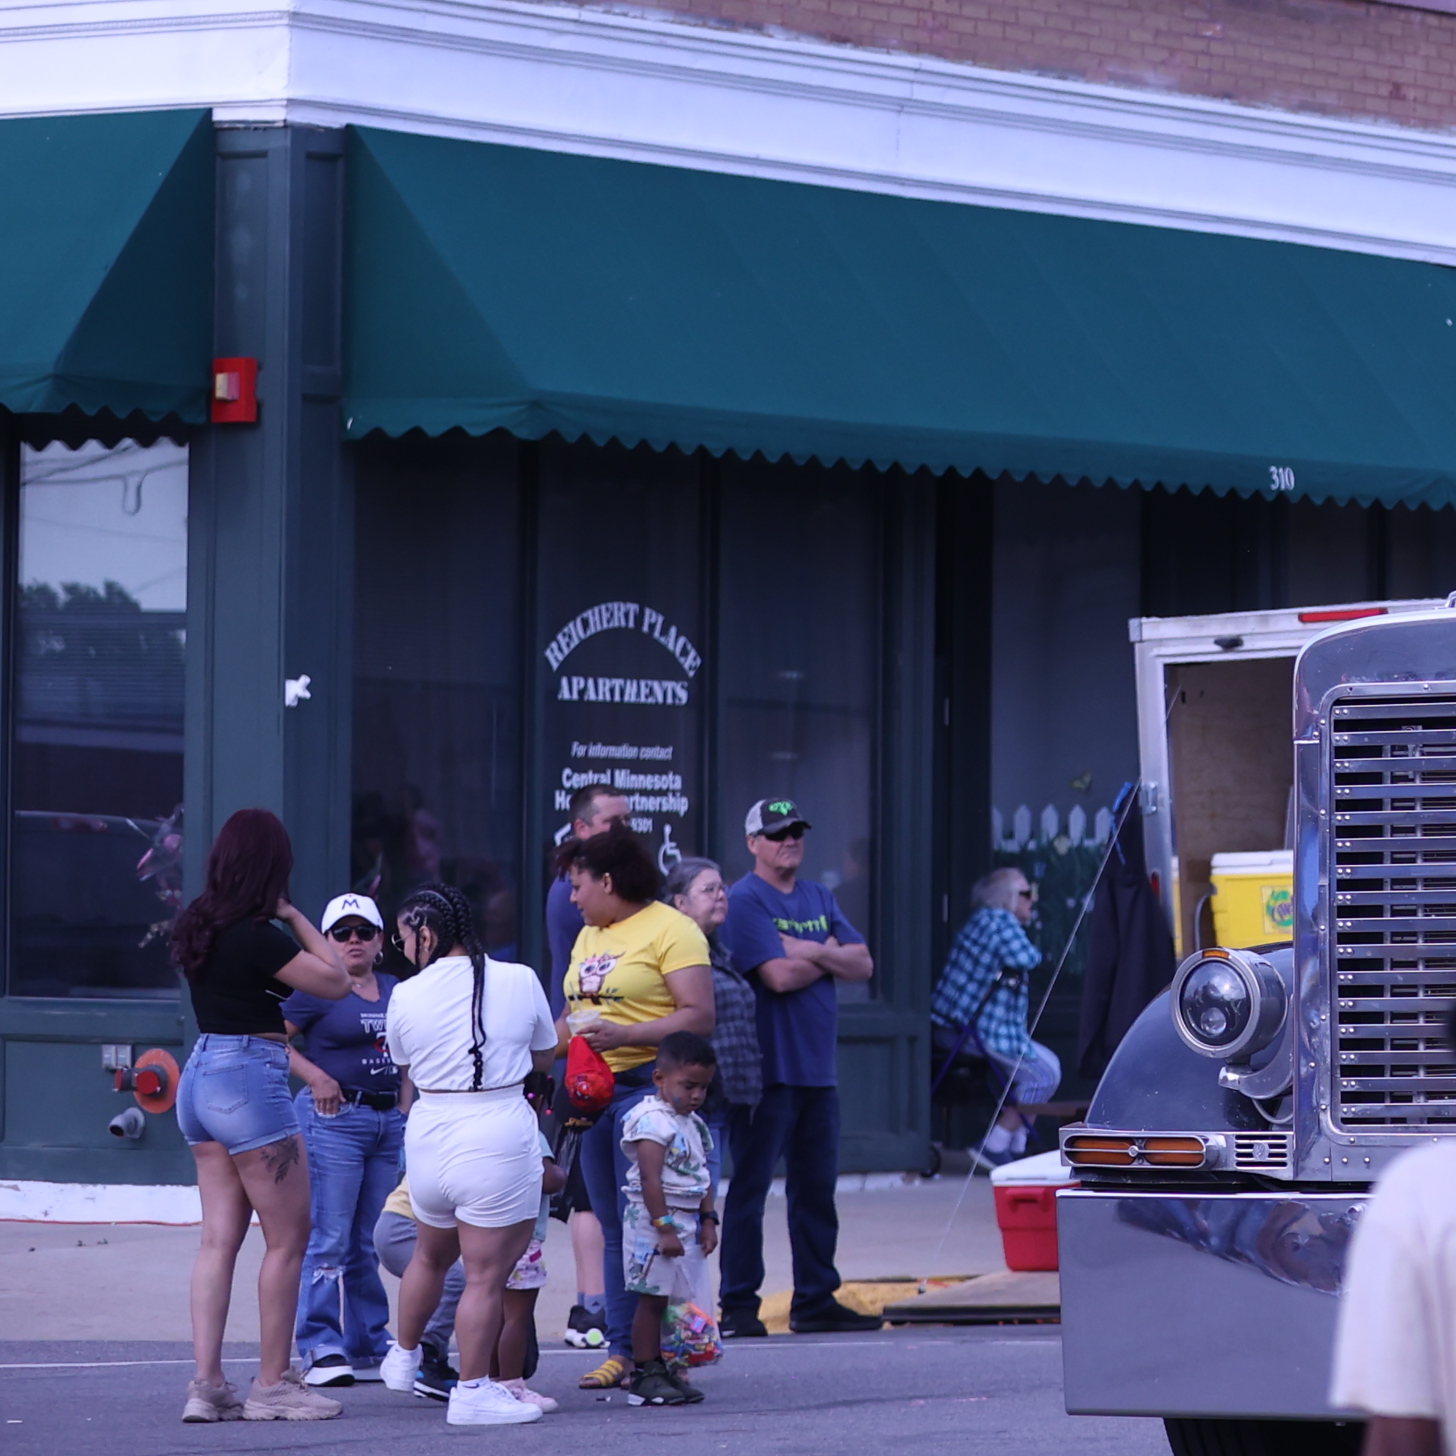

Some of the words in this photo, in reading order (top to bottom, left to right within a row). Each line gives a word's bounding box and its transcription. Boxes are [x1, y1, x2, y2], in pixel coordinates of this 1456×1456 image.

[1269, 465, 1295, 491] 310
[544, 601, 639, 672] REICHERT
[641, 607, 702, 679] PLACE
[558, 675, 689, 706] APARTMENTS
[571, 741, 587, 758] For
[587, 742, 638, 760] information
[639, 745, 673, 760] contact
[562, 767, 611, 789] Central
[613, 768, 682, 790] Minnesota
[624, 792, 688, 817] rtnership
[341, 898, 360, 910] M
